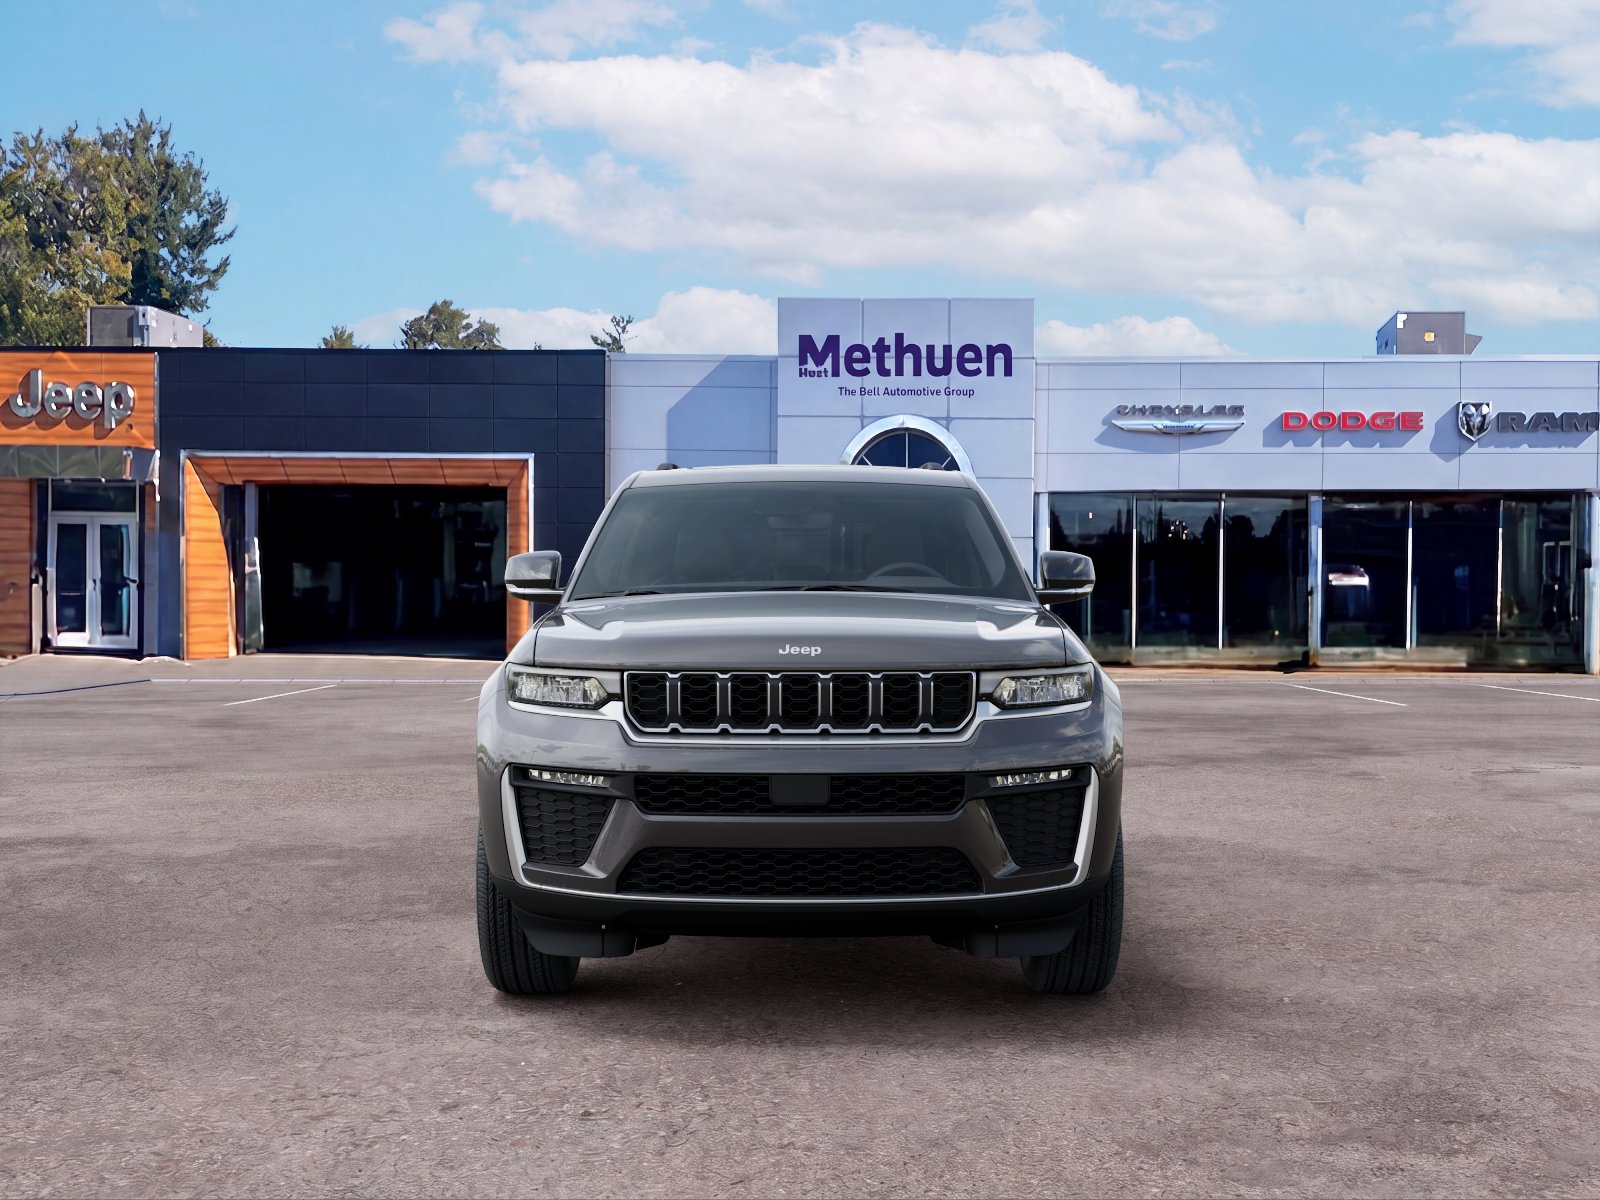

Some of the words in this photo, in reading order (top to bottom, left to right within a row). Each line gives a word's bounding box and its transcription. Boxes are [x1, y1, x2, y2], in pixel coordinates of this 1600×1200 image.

[798, 332, 1013, 378] Methuen
[9, 368, 136, 429] Jeep
[837, 386, 857, 396] The
[859, 386, 880, 396] Bell
[883, 386, 941, 396] Automotive
[944, 386, 975, 398] Group
[1282, 411, 1424, 431] DODGE
[1498, 411, 1599, 432] RAM
[778, 643, 822, 657] Jeep
